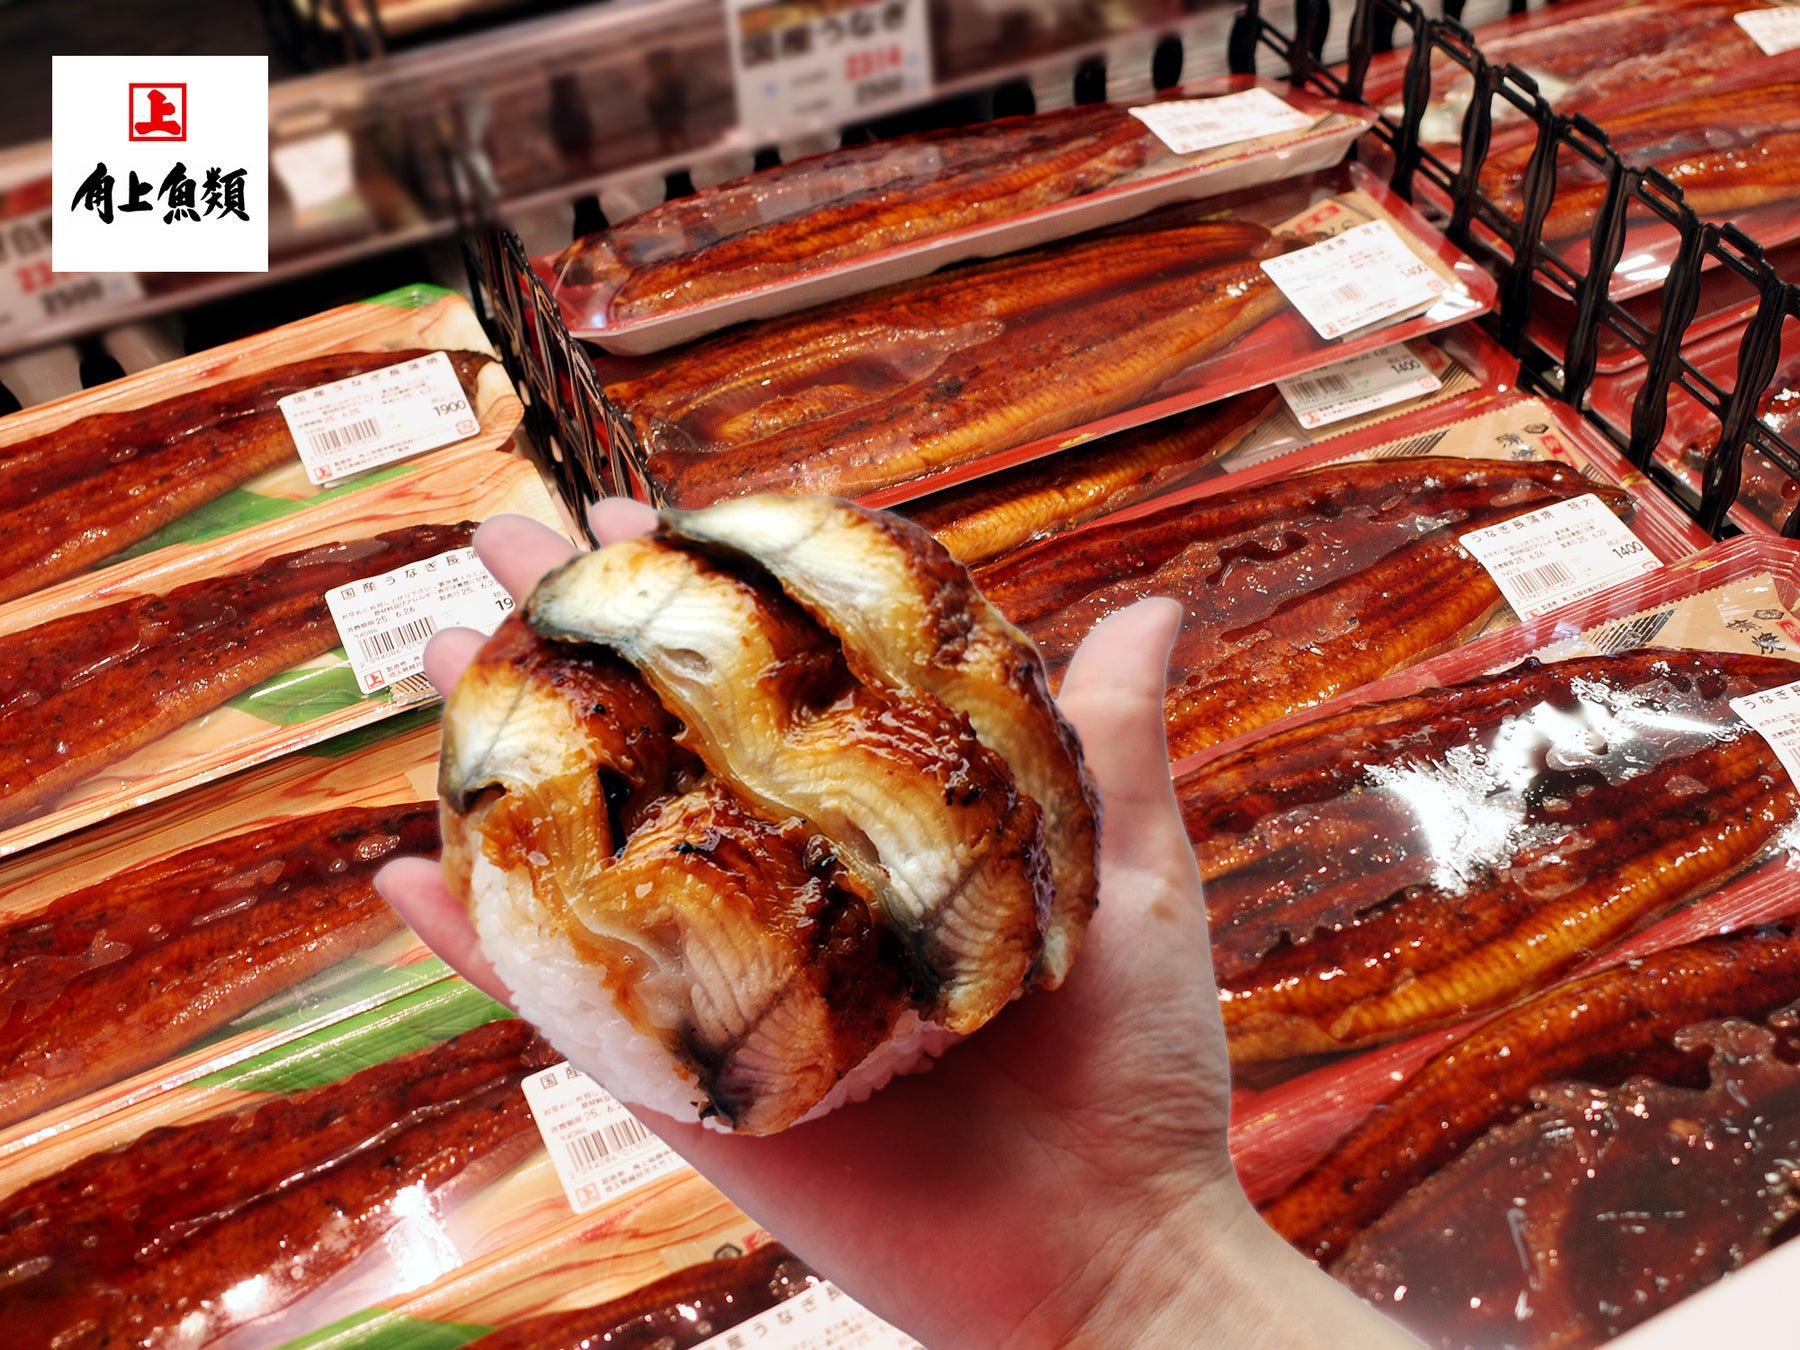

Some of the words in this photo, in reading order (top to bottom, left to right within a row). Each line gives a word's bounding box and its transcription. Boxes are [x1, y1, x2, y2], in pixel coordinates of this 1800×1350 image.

[432, 400, 467, 417] 1900
[1471, 510, 1555, 544] うなぎ長蒲焼
[1611, 540, 1644, 560] 1400
